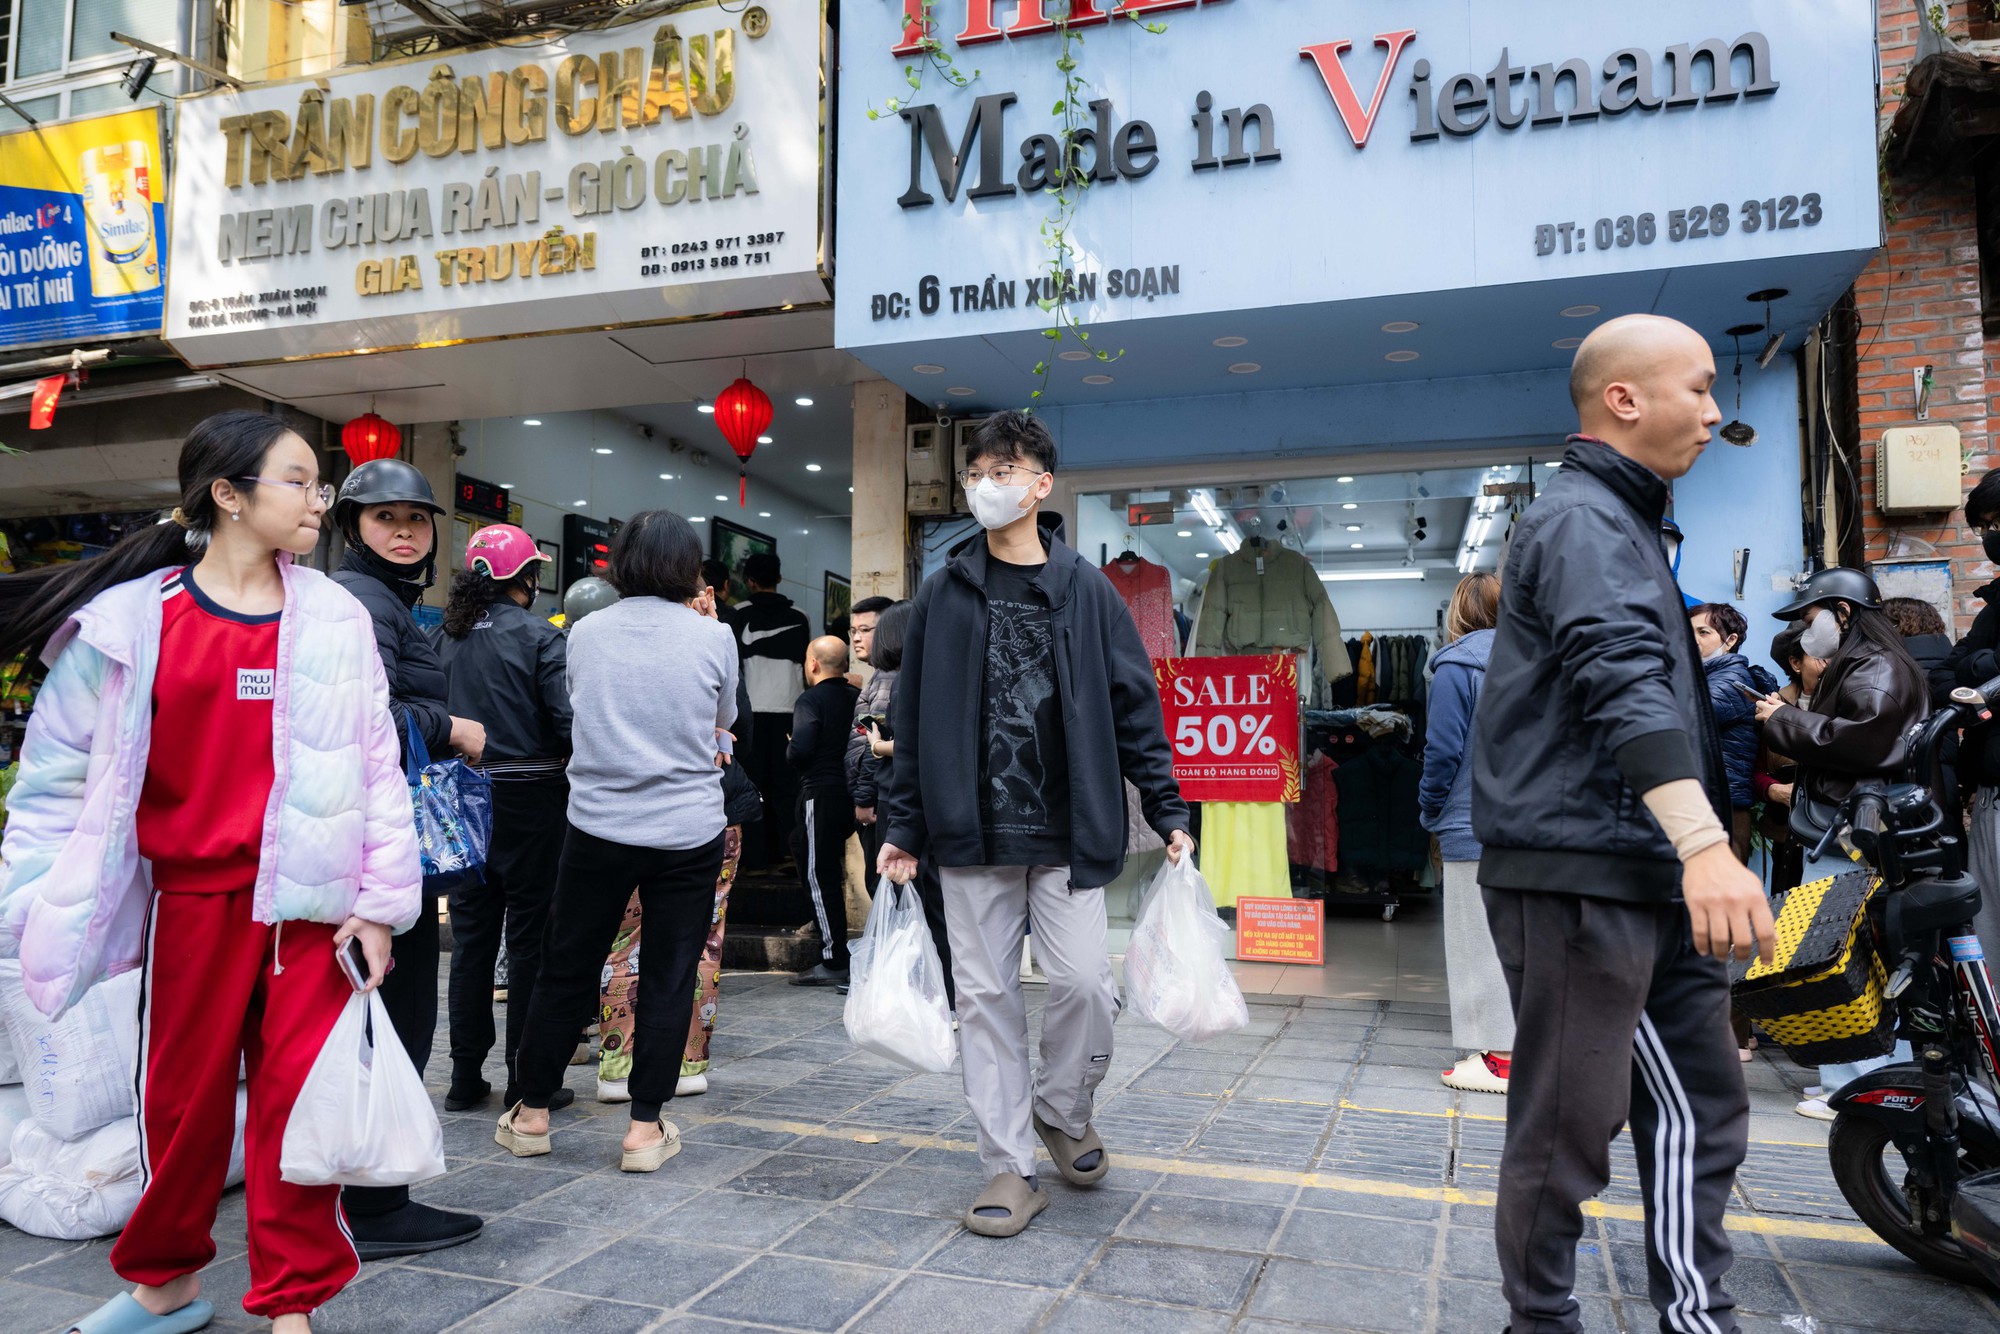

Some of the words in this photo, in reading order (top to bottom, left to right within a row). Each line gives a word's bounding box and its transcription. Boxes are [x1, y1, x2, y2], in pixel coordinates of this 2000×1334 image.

[219, 79, 375, 189] TRẦN
[380, 63, 548, 165] CÔNG
[555, 24, 736, 138] CHÂU
[897, 91, 1160, 209] Made
[1191, 89, 1282, 172] in
[1299, 28, 1780, 149] Vietnam
[217, 203, 313, 269] NEM
[319, 187, 434, 250] CHUA
[653, 121, 760, 206] CHẢ
[63, 205, 73, 224] 4
[101, 218, 145, 239] Similac
[1535, 220, 1586, 256] ĐT:
[1595, 211, 1657, 250] 036
[1668, 202, 1730, 242] 528
[1740, 192, 1823, 233] 3123
[20, 235, 83, 273] DƯỠNG
[671, 240, 709, 255] 0243
[715, 236, 741, 249] 971
[747, 231, 785, 246] 3387
[355, 253, 423, 297] GIA
[435, 225, 598, 287] TRUYỀN
[671, 258, 705, 273] 0913
[710, 255, 738, 268] 588
[744, 251, 771, 265] 751
[13, 276, 41, 308] TRÍ
[43, 271, 75, 305] NHÍ
[293, 285, 328, 300] SOẠN
[870, 292, 911, 321] ĐC:
[918, 274, 940, 315] 6
[950, 273, 1016, 313] TRẦN
[1025, 268, 1097, 306] XUÂN
[1107, 264, 1180, 302] SOẠN
[277, 303, 295, 317] HÀ
[296, 300, 318, 318] NỘI
[463, 485, 474, 500] 13
[1006, 602, 1040, 611] STUDIO
[1174, 674, 1271, 708] SALE
[1175, 714, 1277, 757] 50%
[1175, 767, 1200, 776] TOÀN
[1204, 766, 1216, 777] BỘ
[1220, 767, 1247, 776] HÀNG
[1962, 991, 1994, 1073] NIKKO
